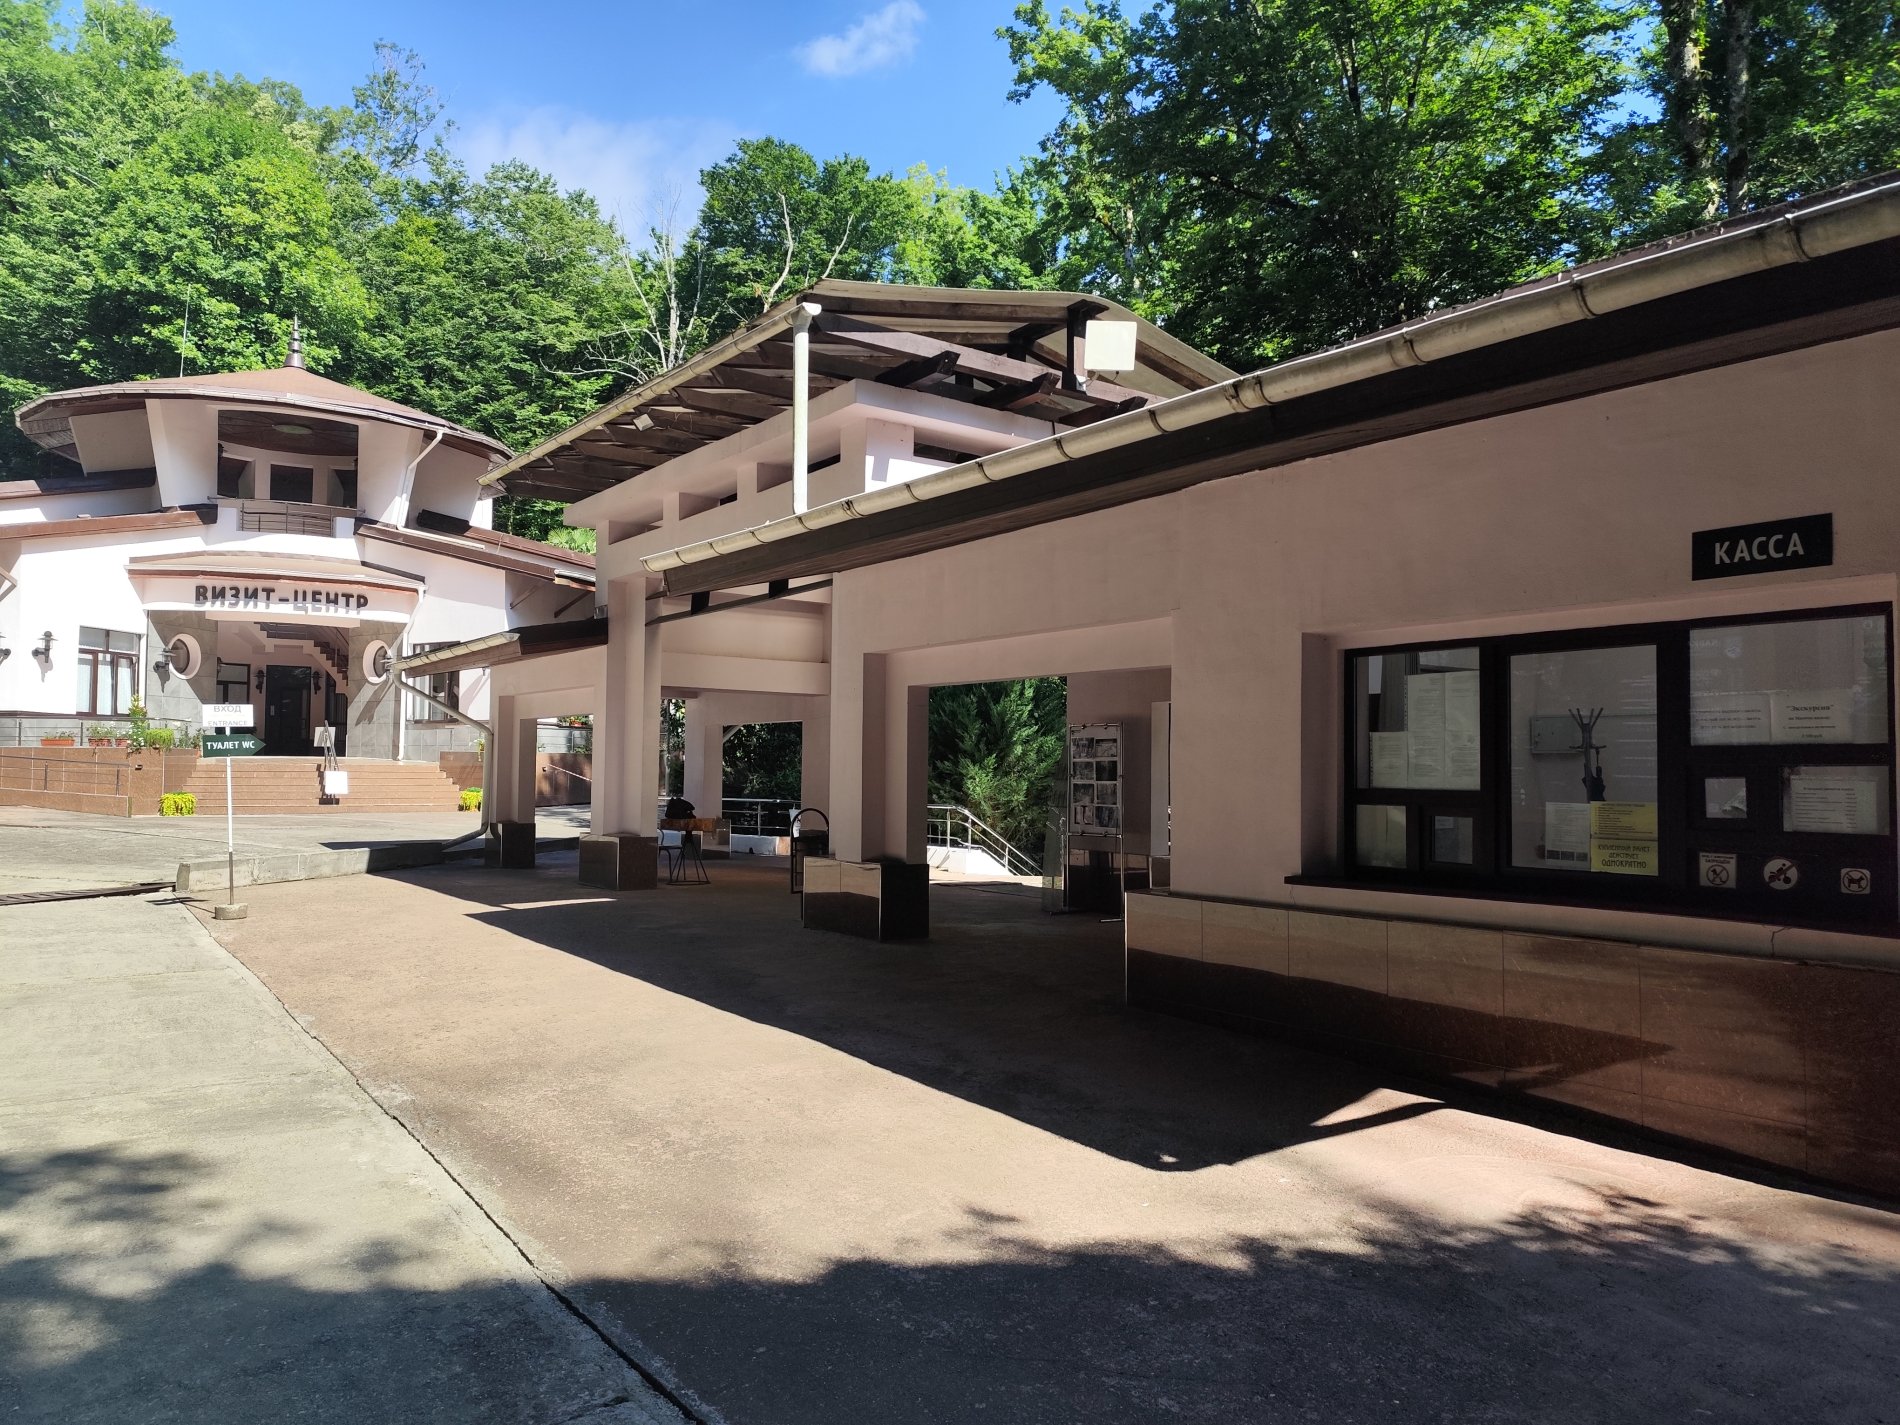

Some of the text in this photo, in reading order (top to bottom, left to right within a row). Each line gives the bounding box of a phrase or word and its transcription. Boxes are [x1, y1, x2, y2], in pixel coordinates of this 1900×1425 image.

[1714, 532, 1804, 565] КАССА
[194, 584, 369, 615] ВИЗИТ-ЦЕНТР
[213, 705, 242, 713] ВХОД
[206, 740, 255, 750] ТУАЛЕТ WC
[1601, 859, 1647, 869] ОДНОКРАТНО
